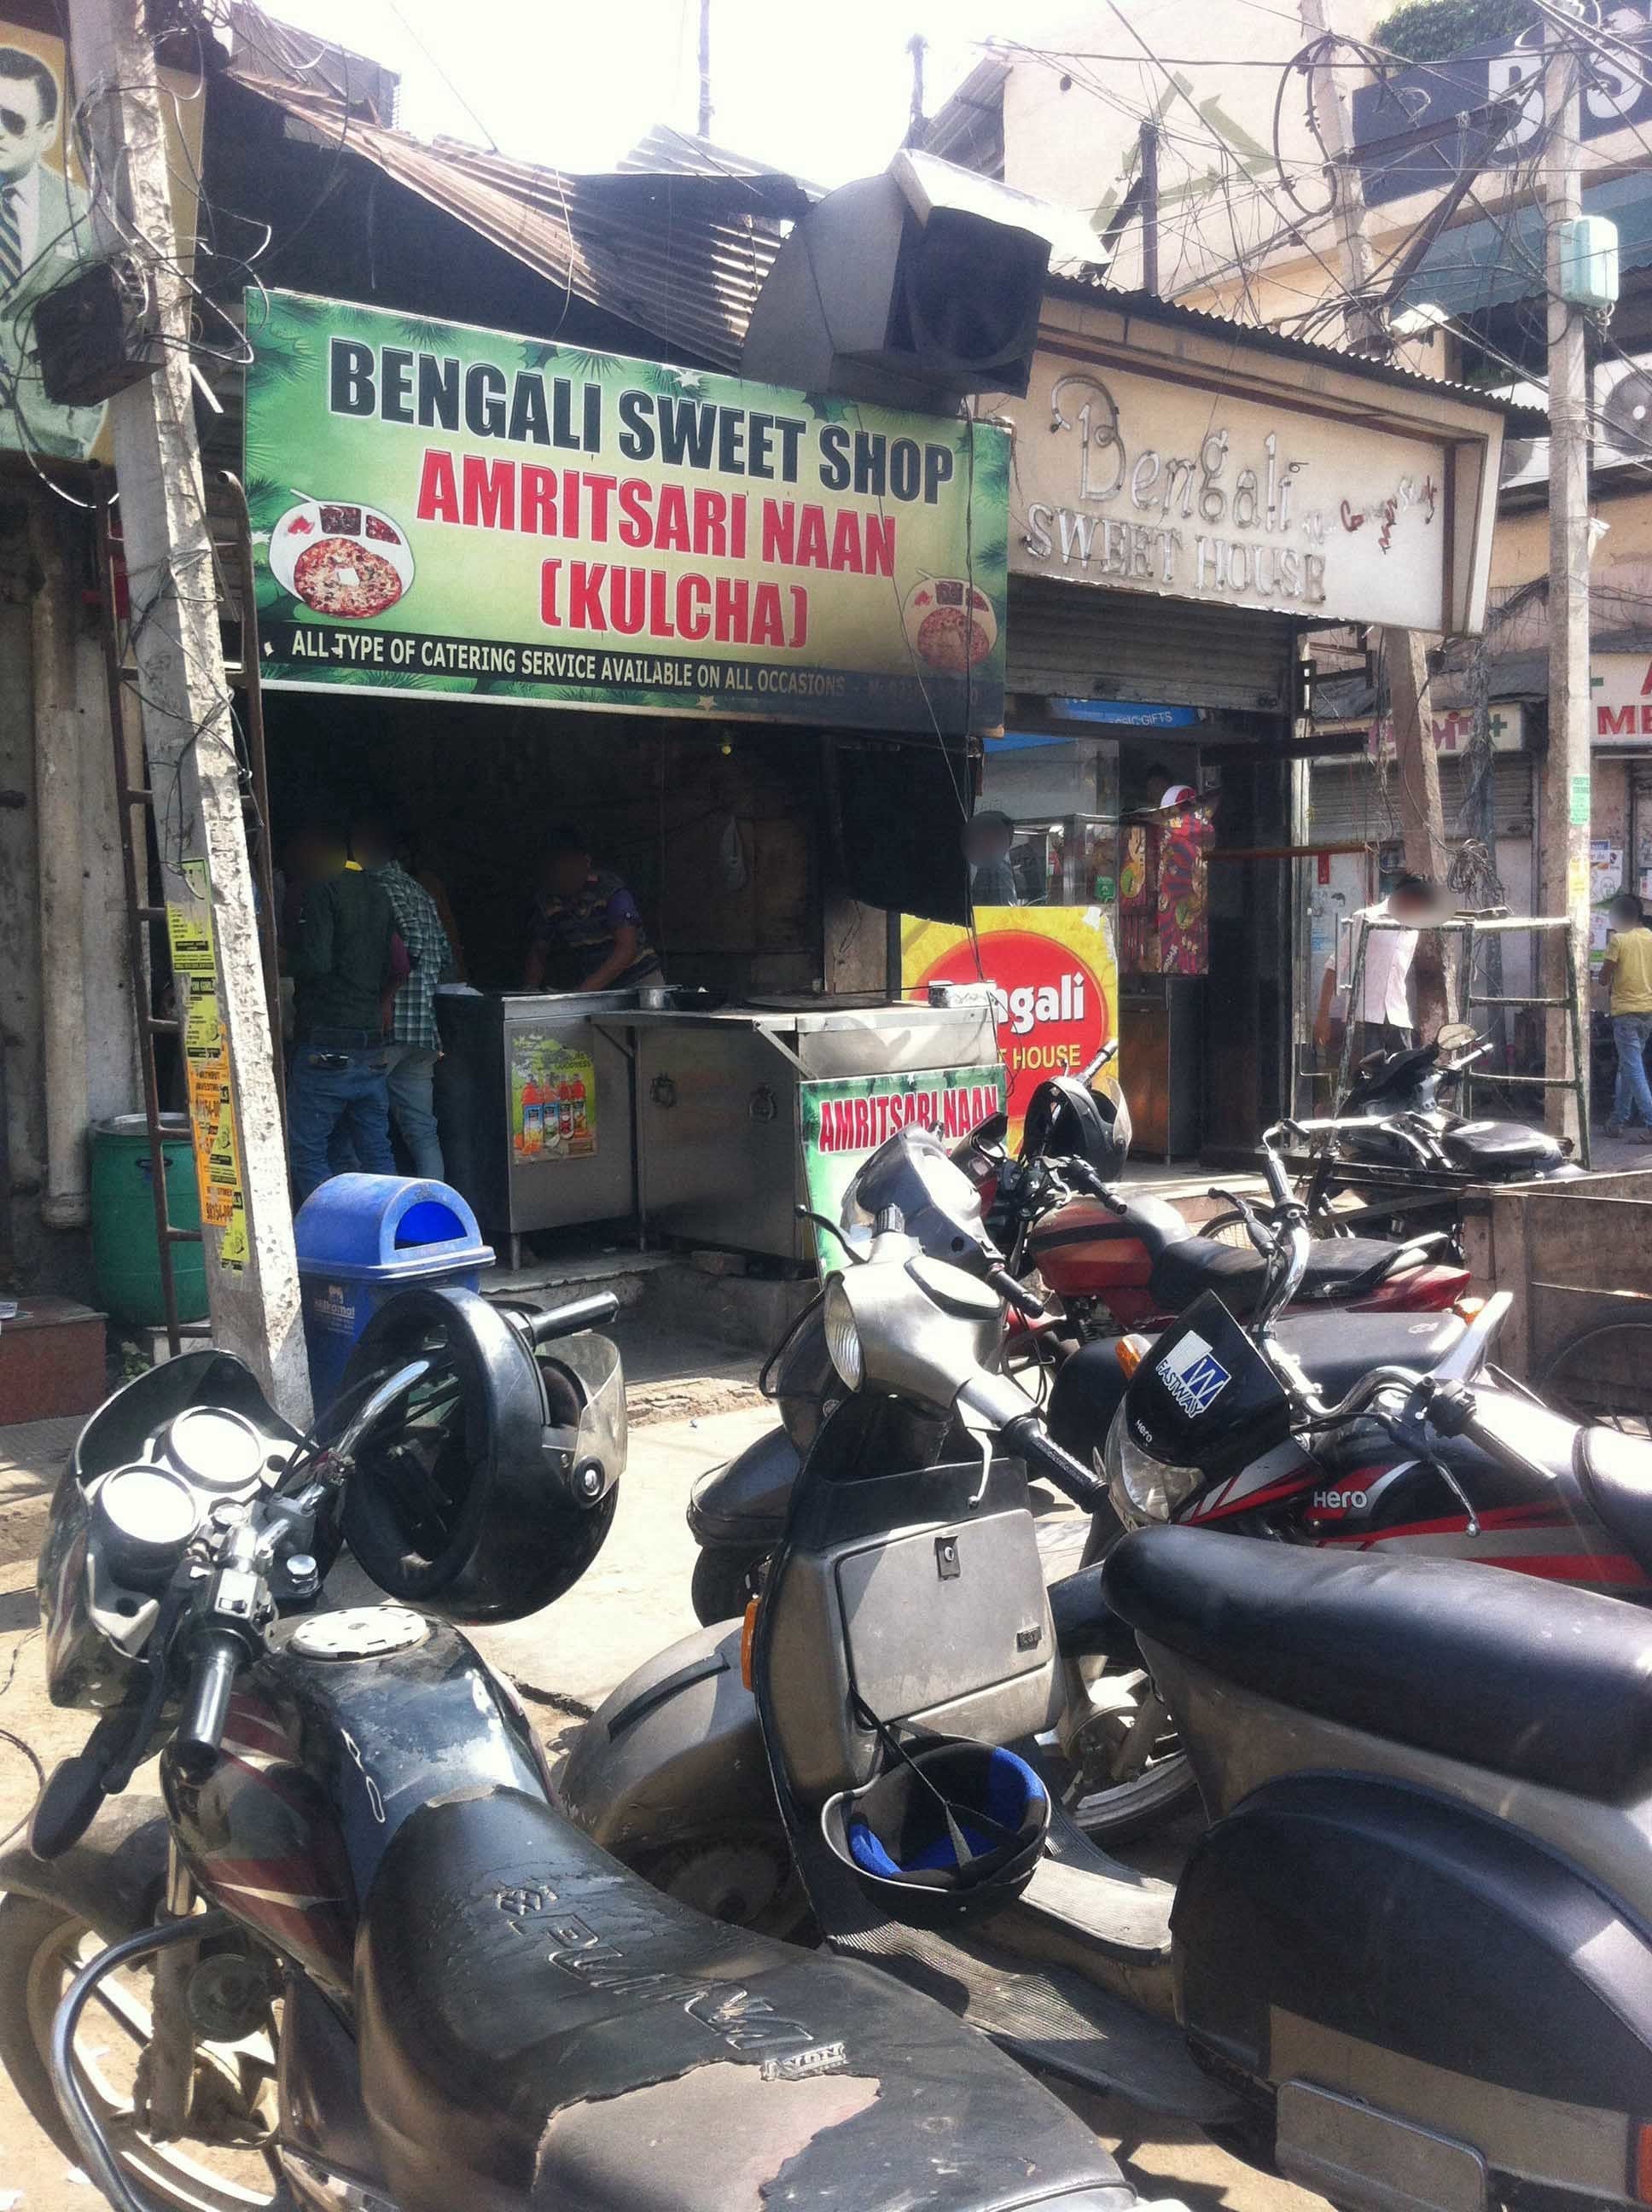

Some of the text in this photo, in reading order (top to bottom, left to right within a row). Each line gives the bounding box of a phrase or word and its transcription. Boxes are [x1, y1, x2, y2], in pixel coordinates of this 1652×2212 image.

[329, 336, 954, 504] BENGALI SWEET SHOP
[416, 448, 896, 579] AMRITSARI NAAN
[1023, 504, 1327, 604] SWEET HOUSE
[292, 630, 338, 658] ALL
[336, 633, 384, 663] TYPE
[390, 639, 416, 664] OF
[422, 642, 518, 673] CATERING
[521, 649, 596, 680] SERVICE
[602, 657, 692, 689] AVAILABLE
[697, 665, 720, 690] ON
[724, 667, 753, 692] ALL
[757, 669, 846, 698] OCCASIONS
[1012, 1043, 1081, 1071] HOUSE
[1155, 1359, 1206, 1419] FASTWAY
